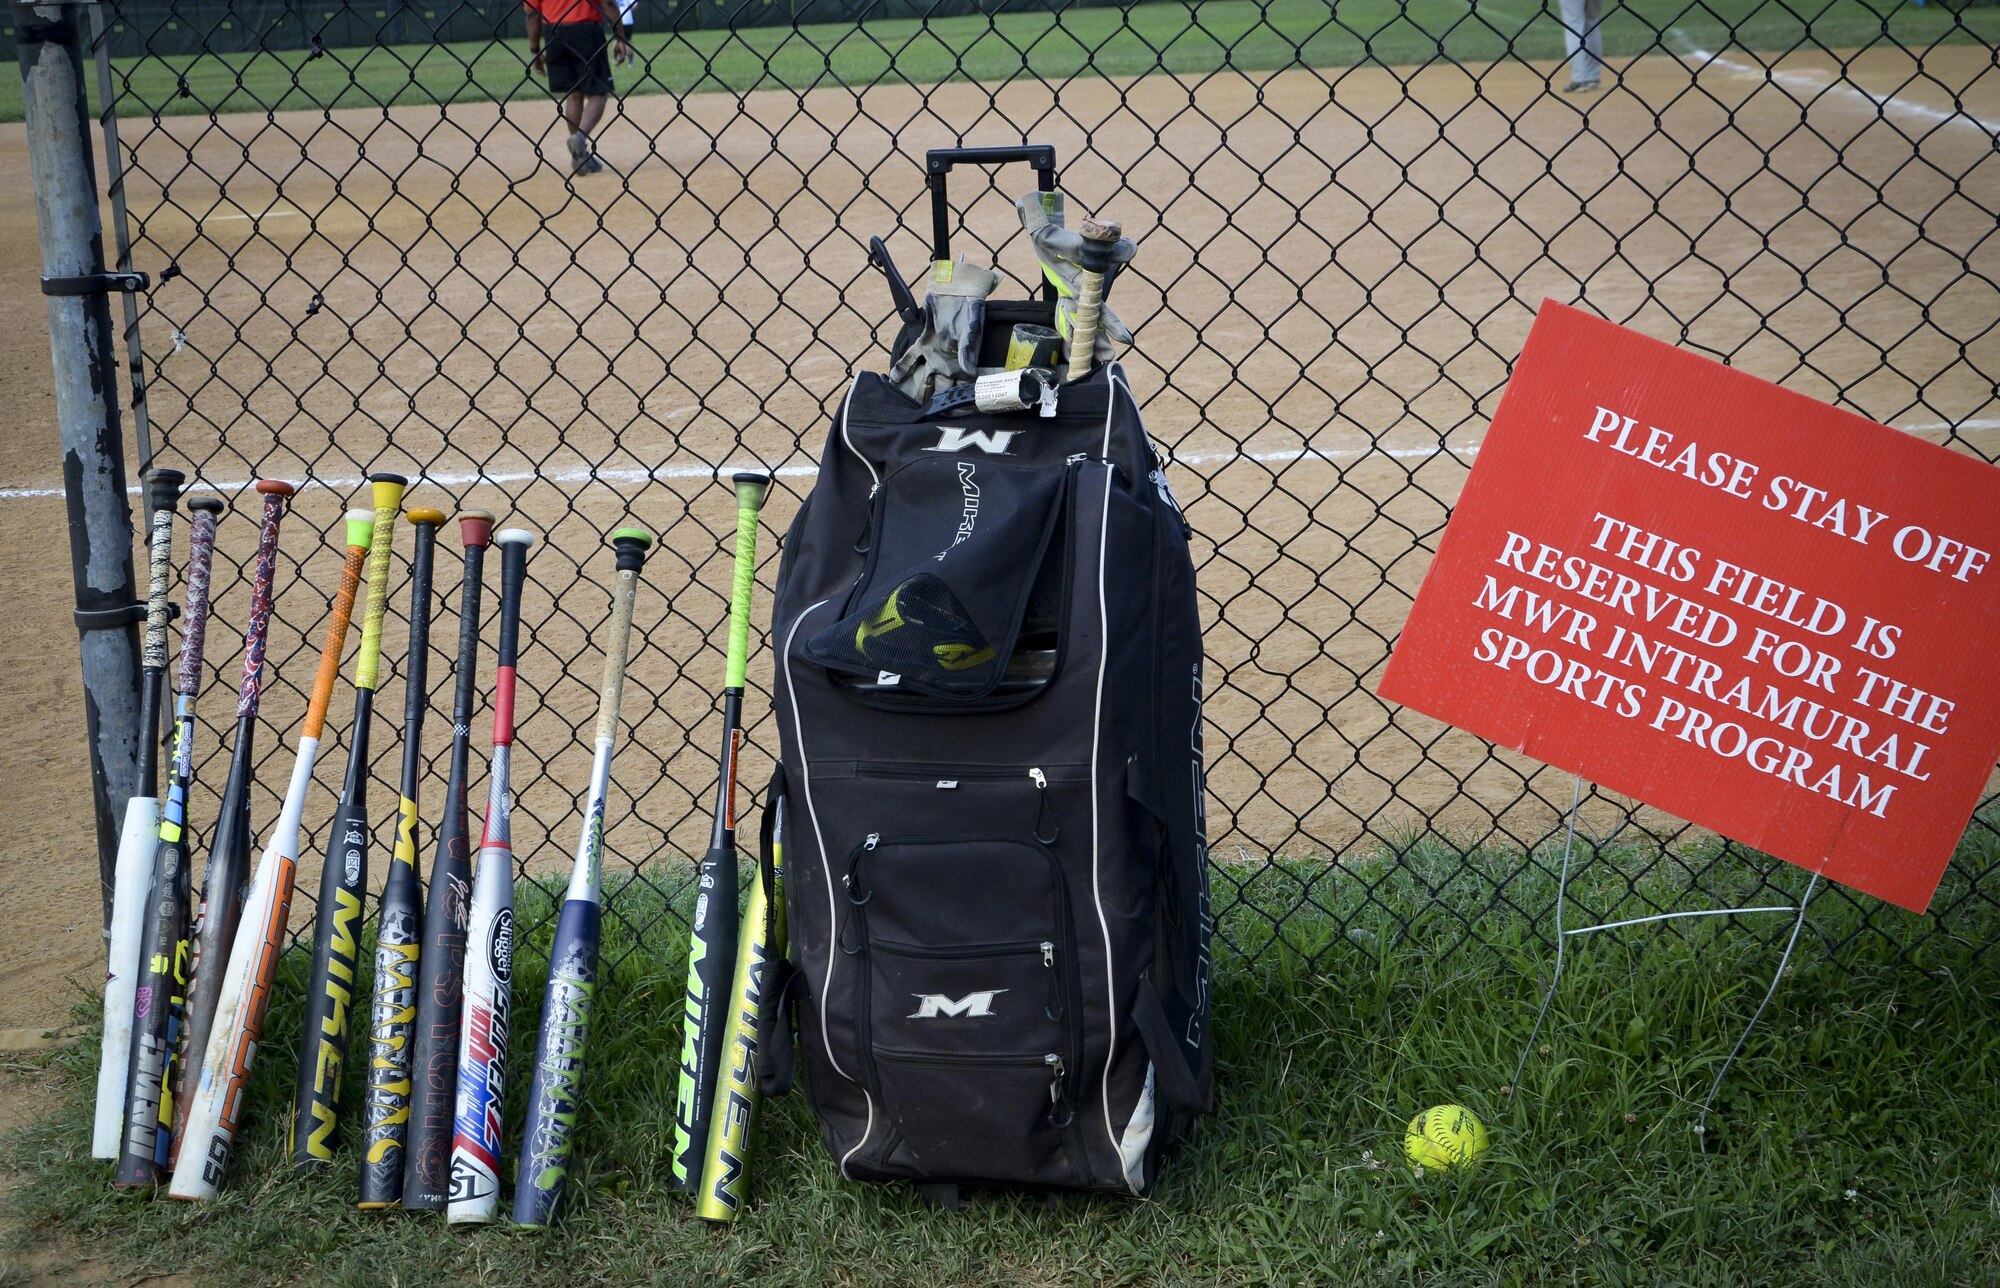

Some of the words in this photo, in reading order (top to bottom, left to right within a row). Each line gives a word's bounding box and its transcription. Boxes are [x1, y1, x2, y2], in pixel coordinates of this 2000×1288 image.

[933, 461, 980, 561] MIKE
[1583, 406, 1759, 499] PLEASE
[1762, 476, 1889, 545] STAY
[1893, 526, 1991, 583] OFF
[1591, 512, 1700, 582] THIS
[1704, 560, 1846, 636] FIELD
[1851, 616, 1902, 660] IS
[1472, 576, 1596, 651] MWR
[1603, 626, 1931, 781] INTRAMURAL
[1474, 628, 1647, 718] SPORTS
[1650, 697, 1898, 819] PROGRAM
[1495, 531, 1737, 648] RESERVED
[1743, 628, 1842, 692] FOR
[1856, 667, 1956, 735] THE
[306, 886, 361, 1160] MIKEN
[494, 916, 513, 976] Slugger
[366, 941, 420, 1164] MANIAC
[672, 931, 708, 1184] MIKEN
